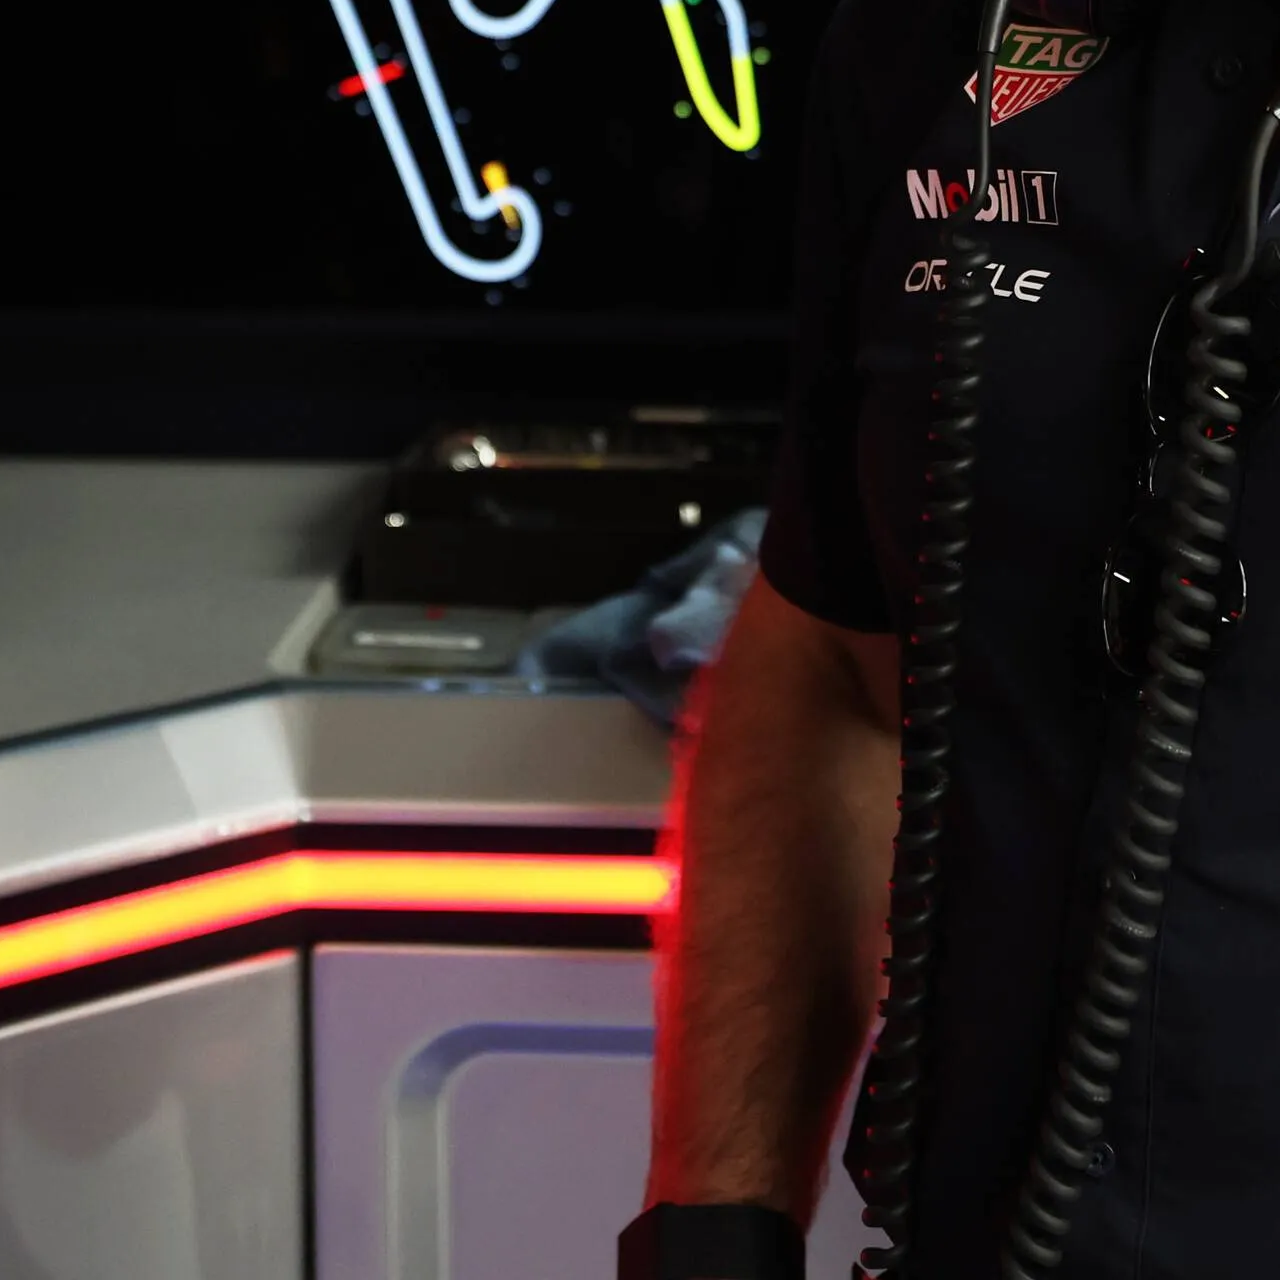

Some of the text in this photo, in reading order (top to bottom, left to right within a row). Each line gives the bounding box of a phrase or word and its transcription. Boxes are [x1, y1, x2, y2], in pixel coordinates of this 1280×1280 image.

[1009, 34, 1099, 69] TAG
[991, 74, 1075, 120] EUER
[906, 168, 1020, 223] Mobil
[904, 258, 1052, 303] ORLE
